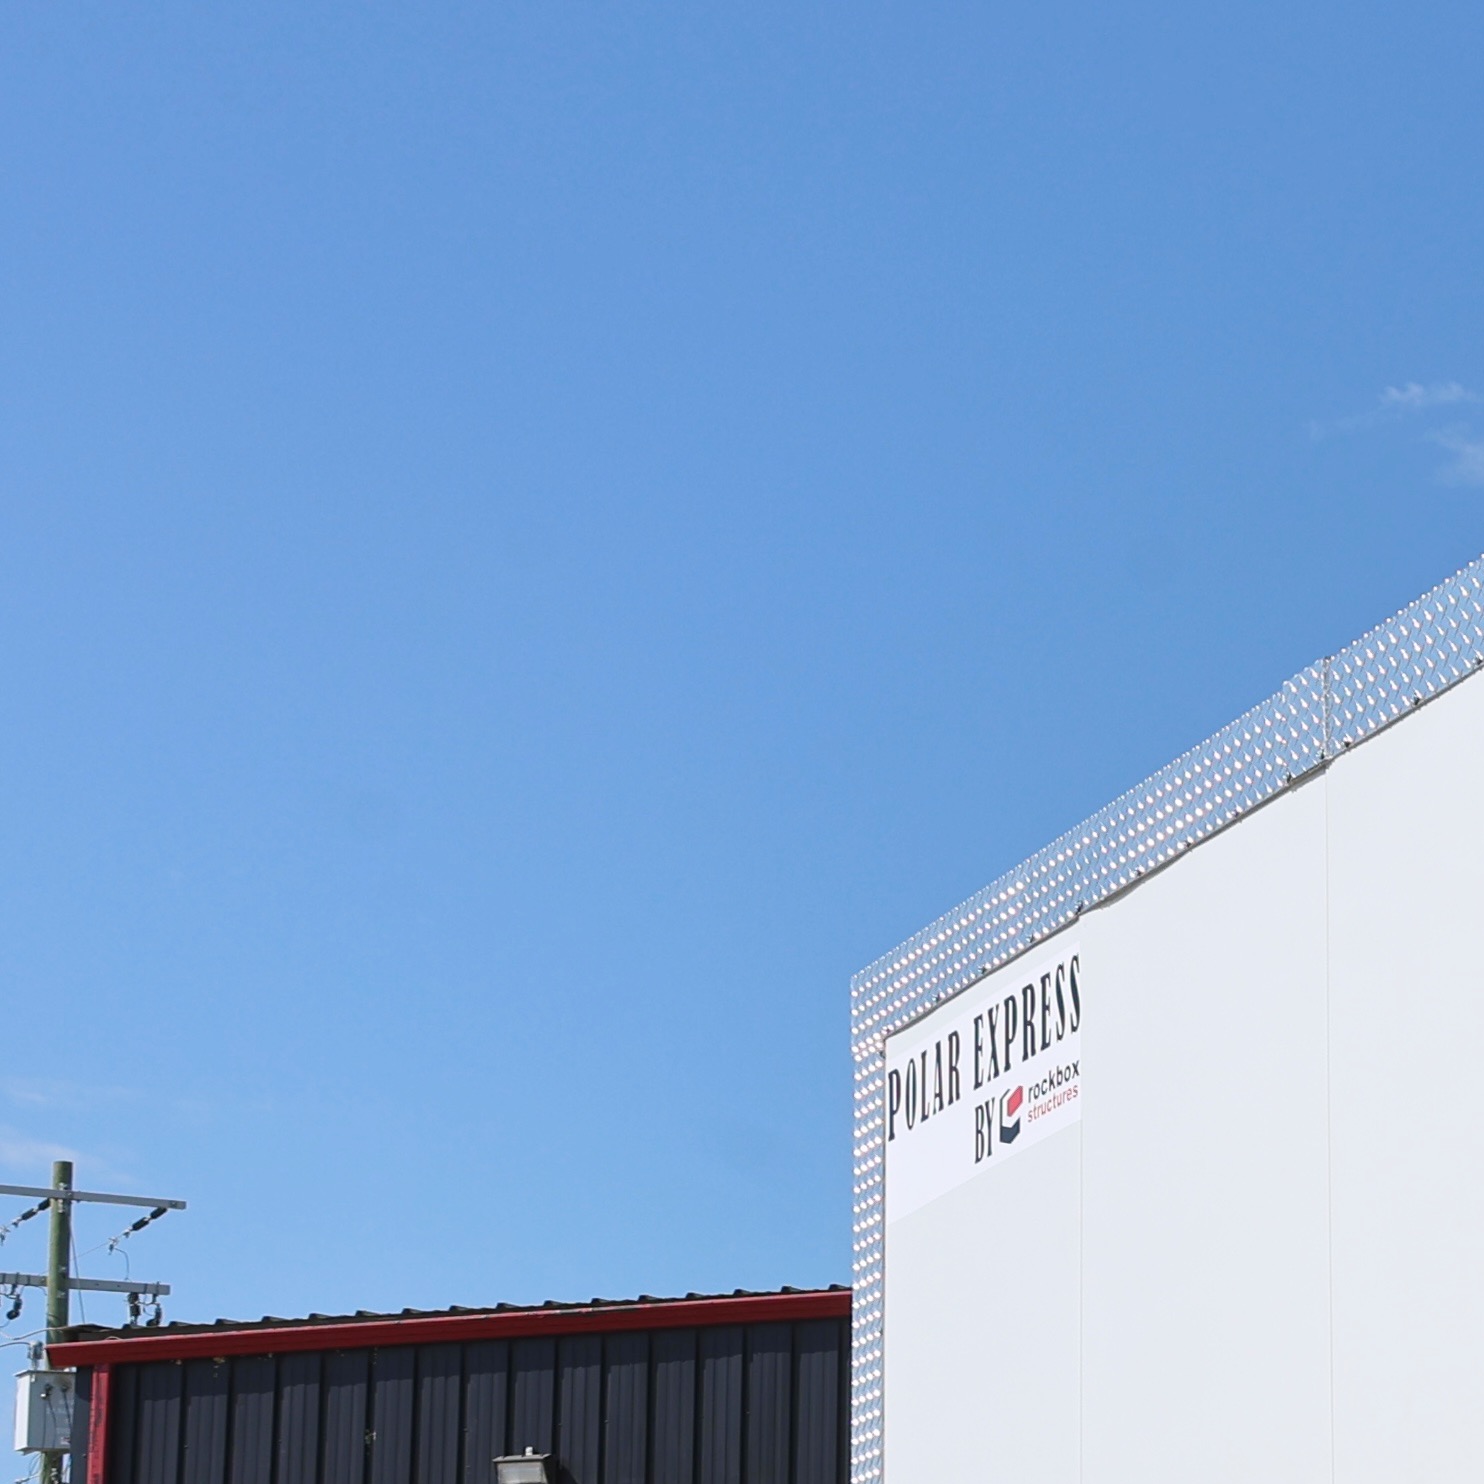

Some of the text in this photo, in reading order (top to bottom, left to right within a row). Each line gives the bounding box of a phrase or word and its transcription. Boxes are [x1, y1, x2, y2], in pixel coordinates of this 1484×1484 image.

[888, 952, 1081, 1142] POLAR EXPRESS
[1028, 1060, 1080, 1103] rockbox
[1028, 1084, 1079, 1122] structures
[974, 1097, 996, 1164] BY
